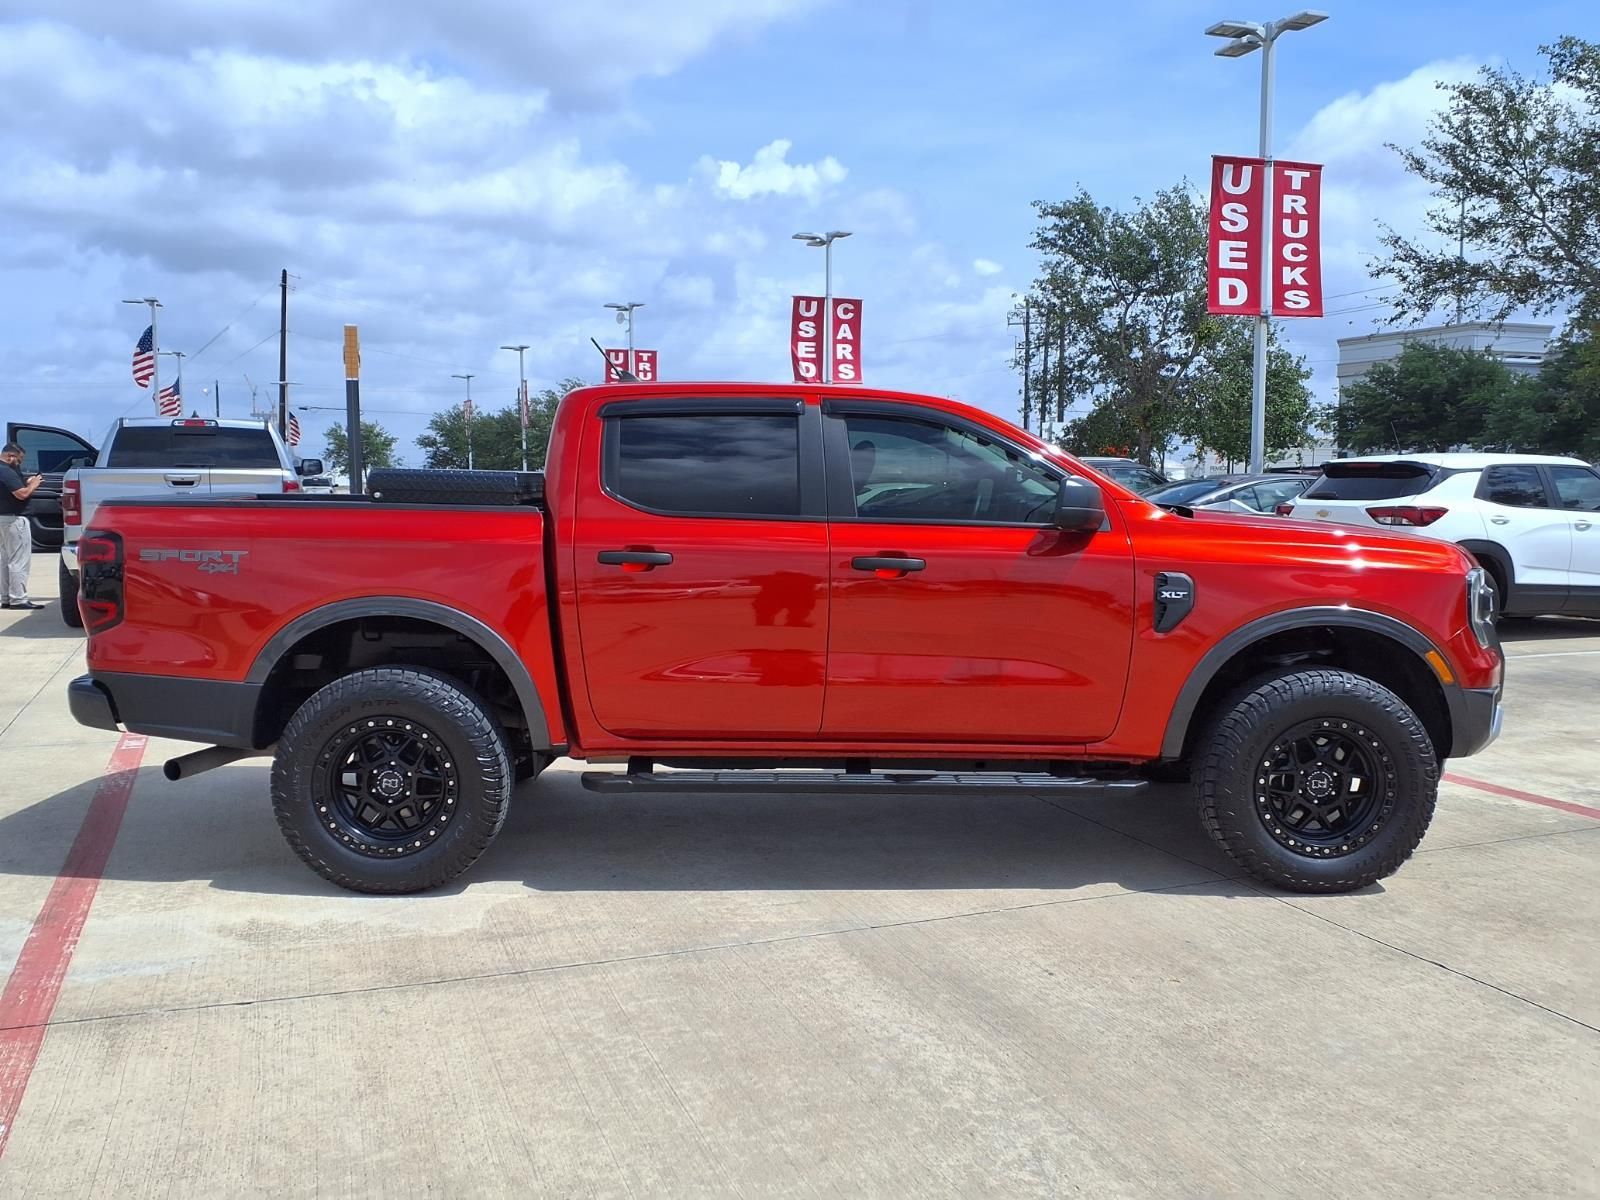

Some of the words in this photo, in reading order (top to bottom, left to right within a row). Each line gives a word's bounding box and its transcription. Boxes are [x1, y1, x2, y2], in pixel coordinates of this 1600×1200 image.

[1218, 164, 1253, 306] USED
[1282, 170, 1311, 310] TRUCKS
[797, 300, 818, 378] USED
[836, 303, 856, 380] CARS
[139, 549, 249, 562] SPORT
[1160, 591, 1188, 599] XLT
